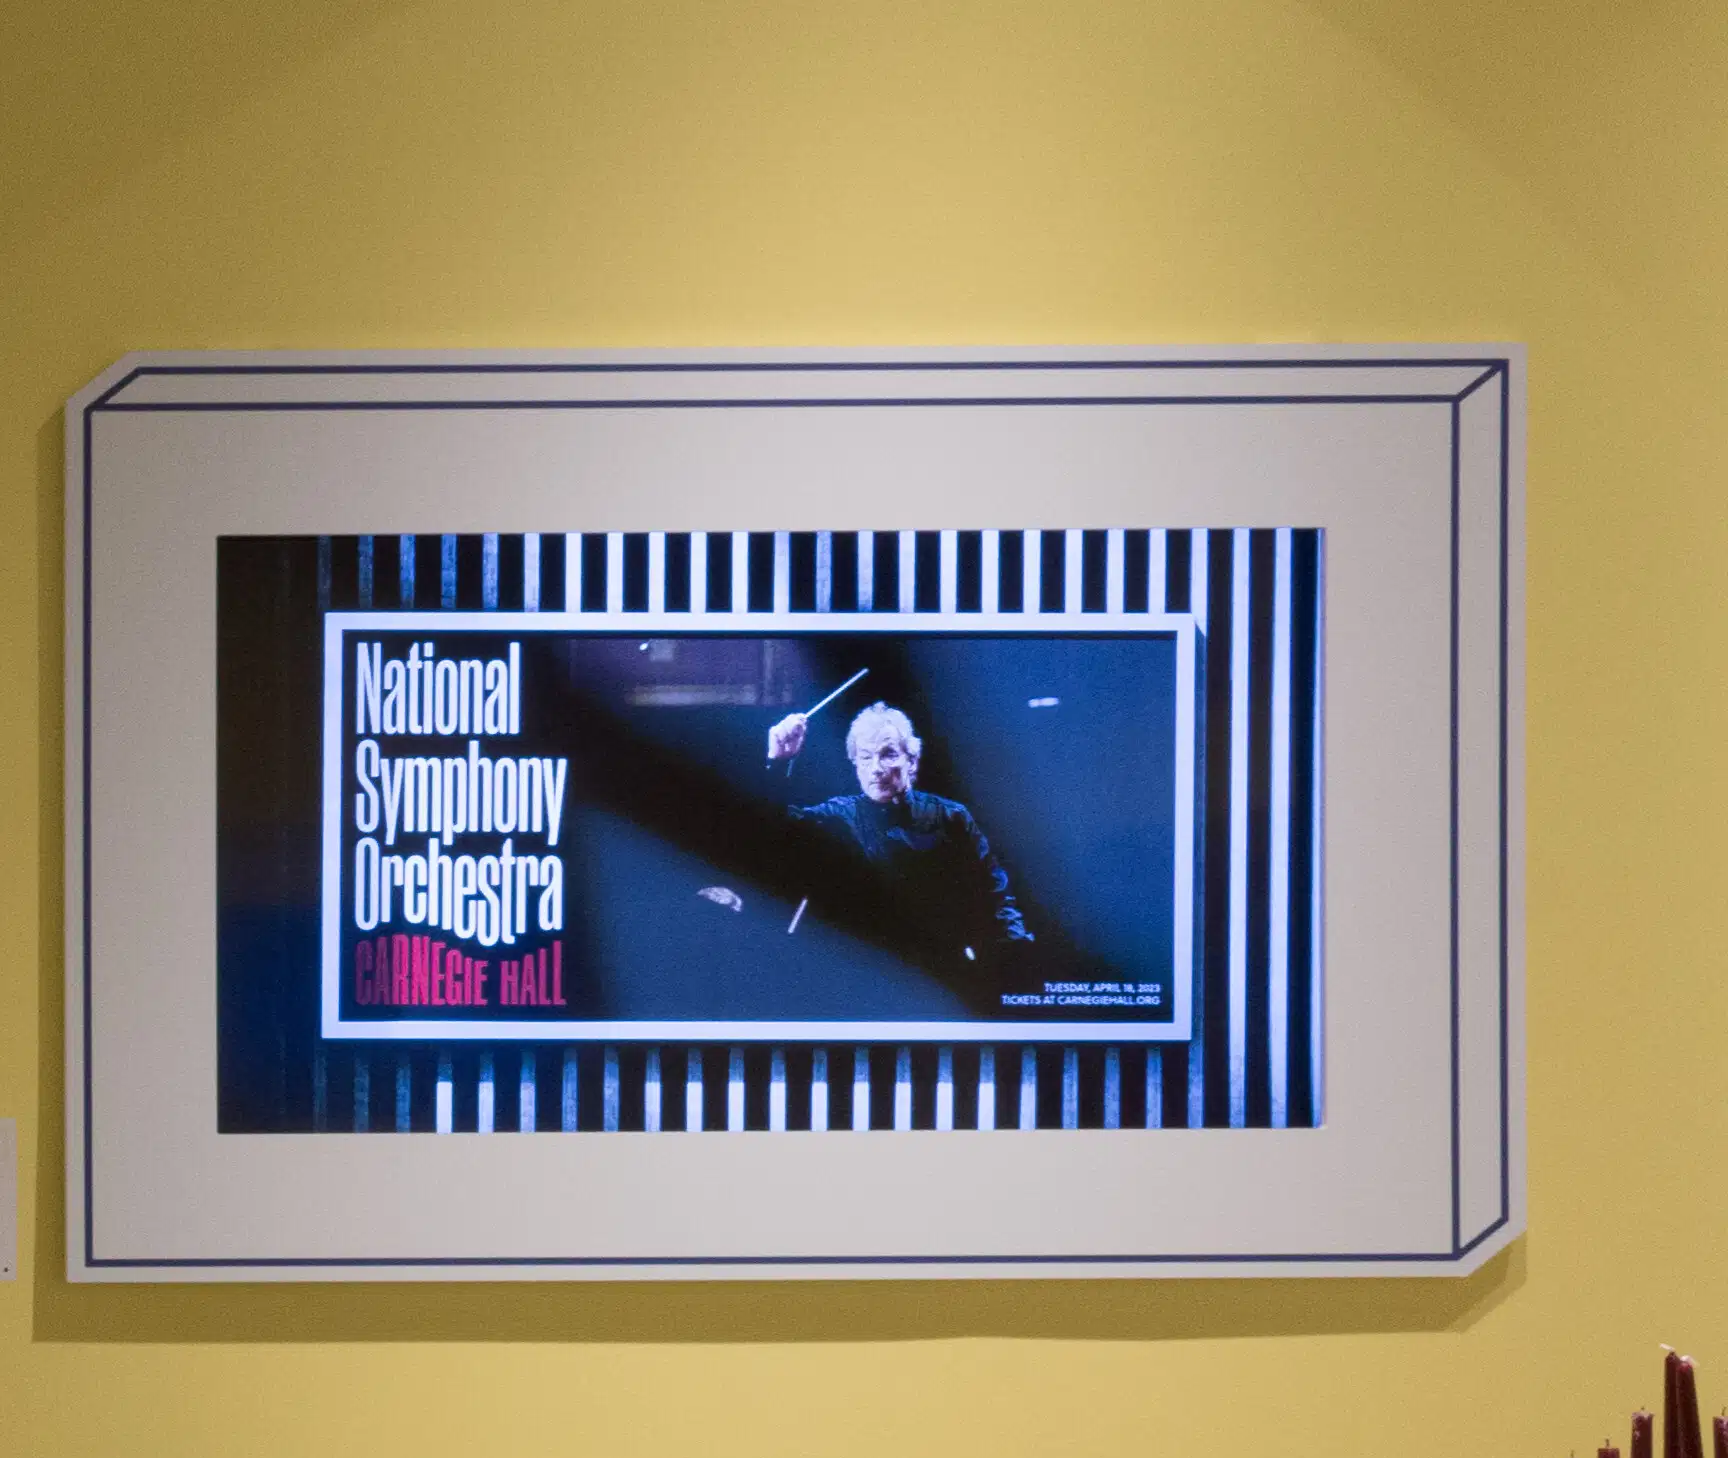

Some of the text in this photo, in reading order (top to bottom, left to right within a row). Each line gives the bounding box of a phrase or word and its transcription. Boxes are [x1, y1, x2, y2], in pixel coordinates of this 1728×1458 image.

[356, 641, 520, 734] National
[355, 741, 566, 846] Symphony
[355, 836, 562, 946] Orchestra
[355, 935, 566, 1006] CARNEGIE HALL
[1001, 995, 1160, 1005] TICKETS AT CARNEGIEHALL.ORG
[1044, 982, 1090, 994] TUESDAY,
[1092, 982, 1120, 993] APRIL
[1138, 982, 1160, 993] 2023
